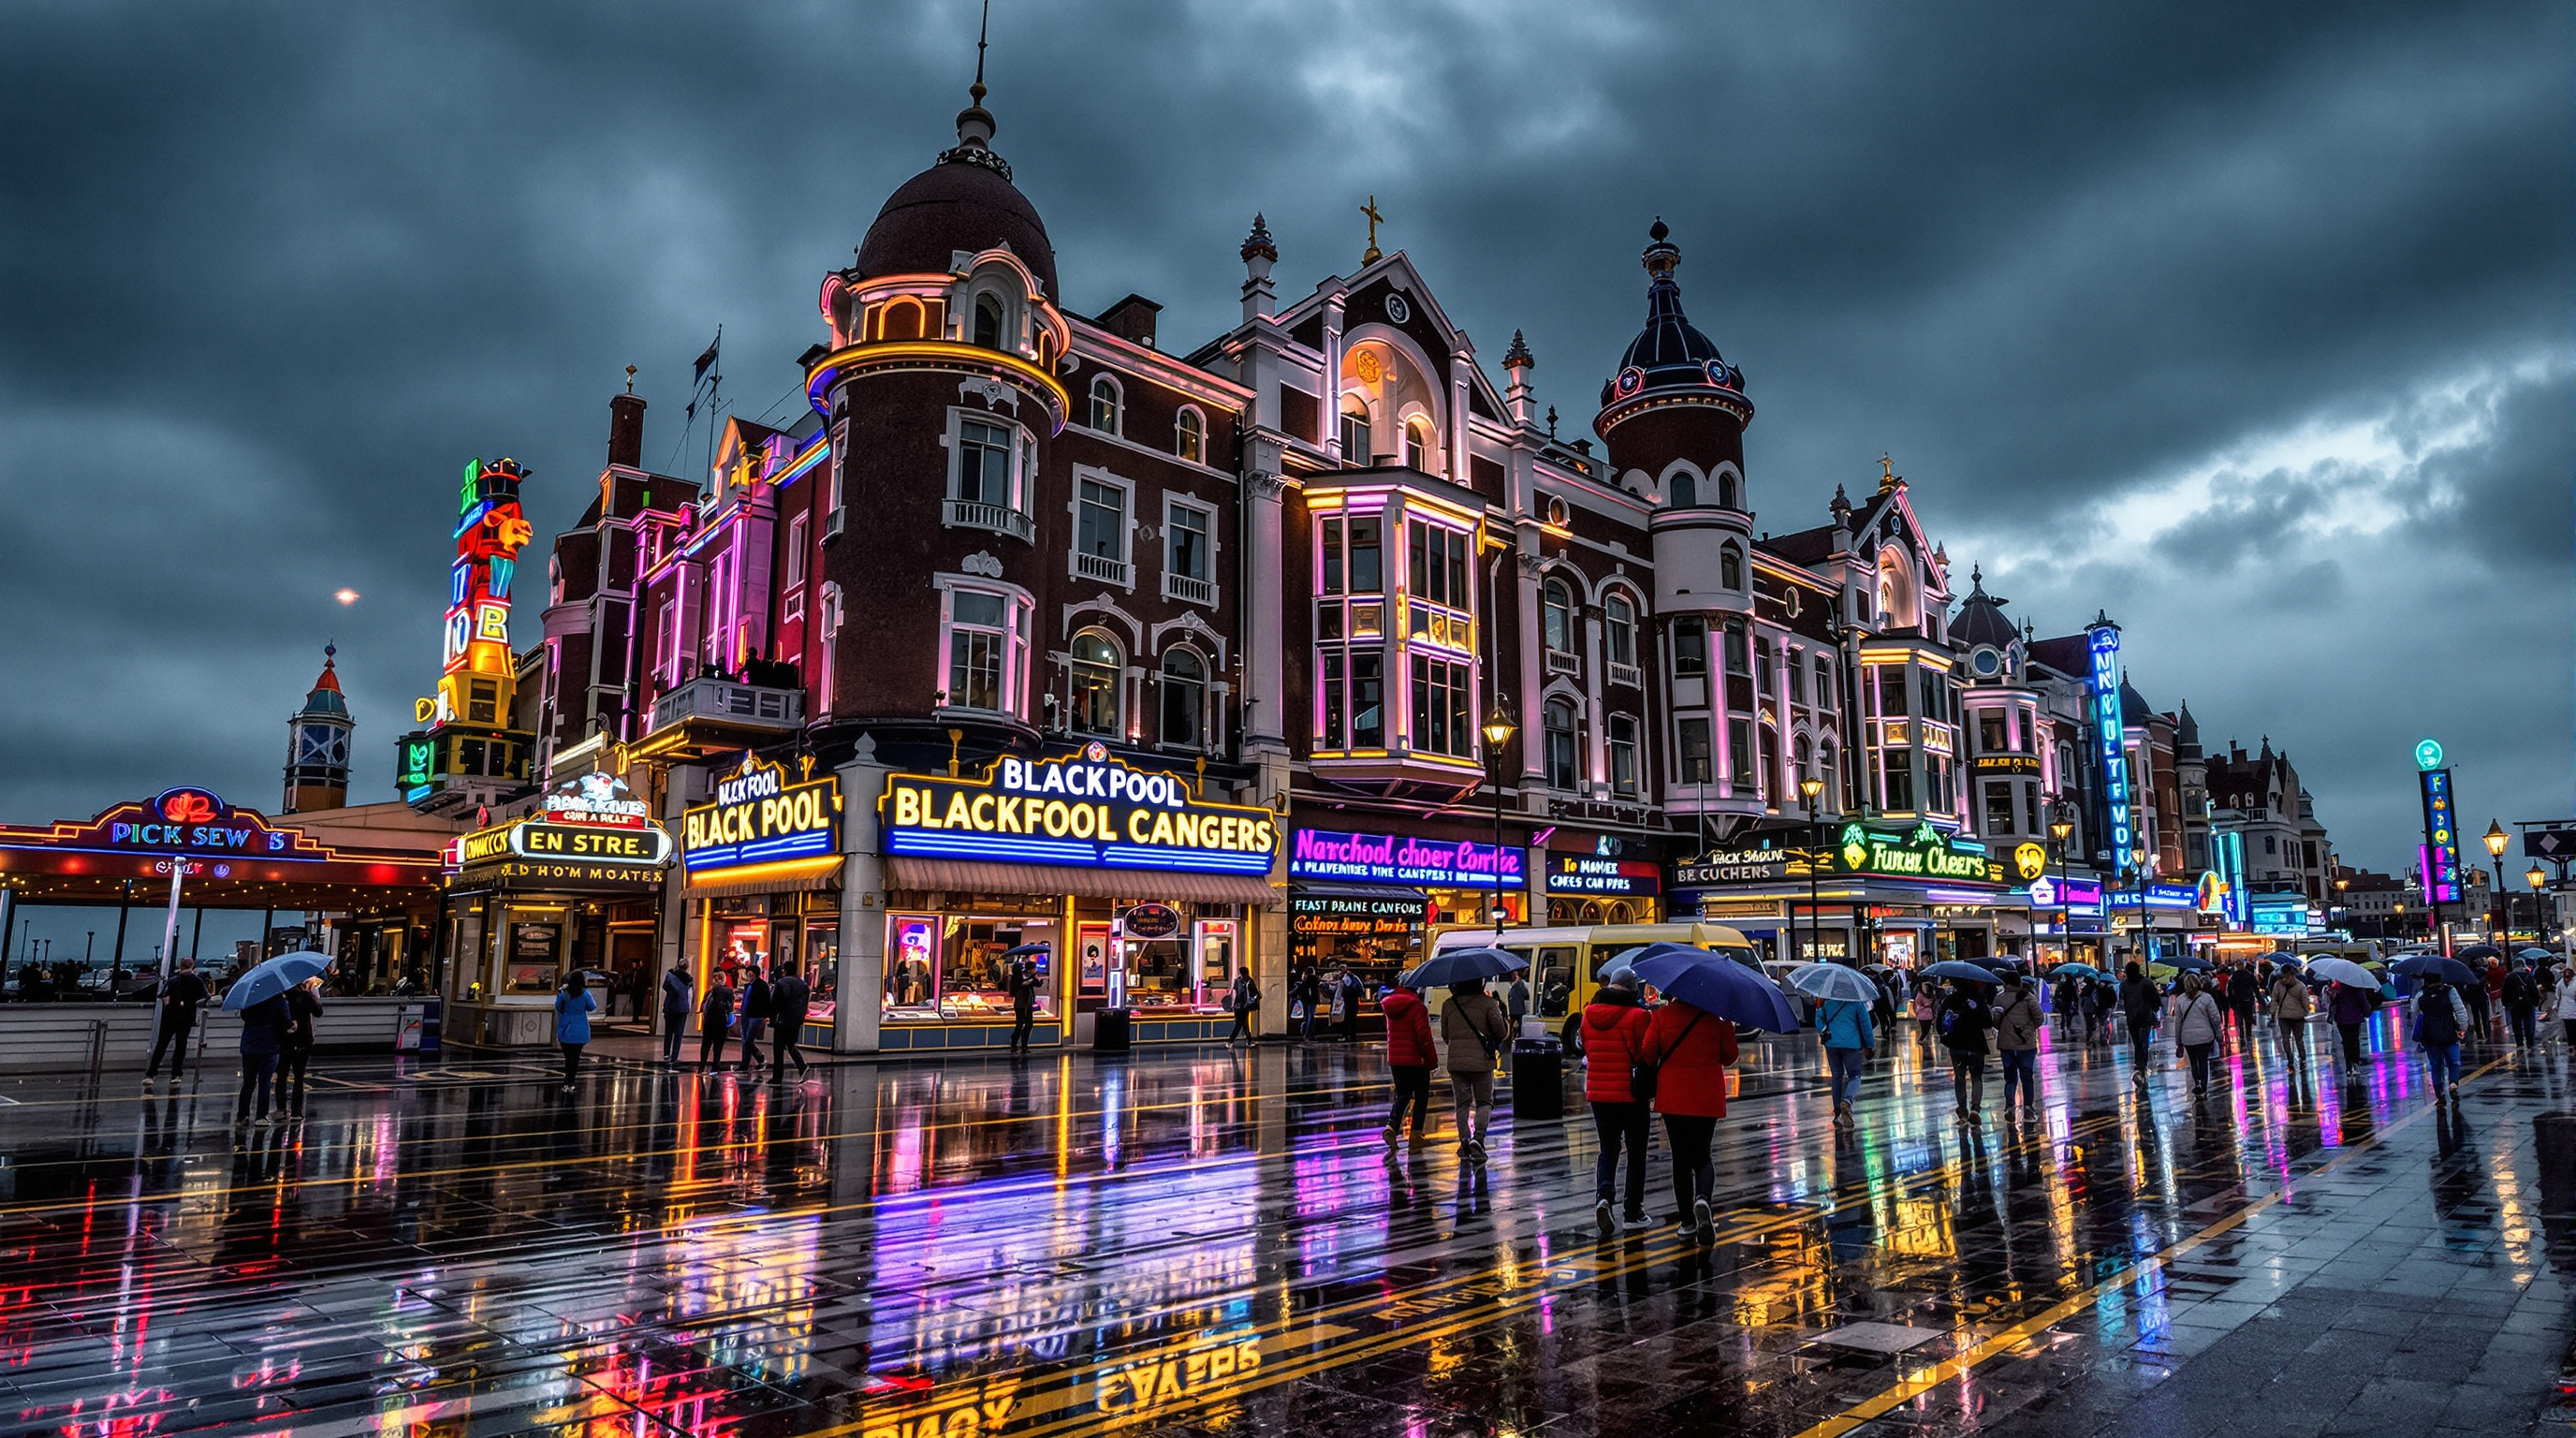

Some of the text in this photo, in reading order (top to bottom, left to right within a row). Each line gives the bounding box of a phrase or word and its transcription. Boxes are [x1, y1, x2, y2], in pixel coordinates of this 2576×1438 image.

[112, 822, 183, 844] PICK
[191, 827, 252, 848] SEW
[687, 802, 755, 850] BLACK
[761, 787, 830, 838] POOL
[895, 786, 1272, 853] BLACKFOOL CANGERS
[530, 831, 563, 851] EN
